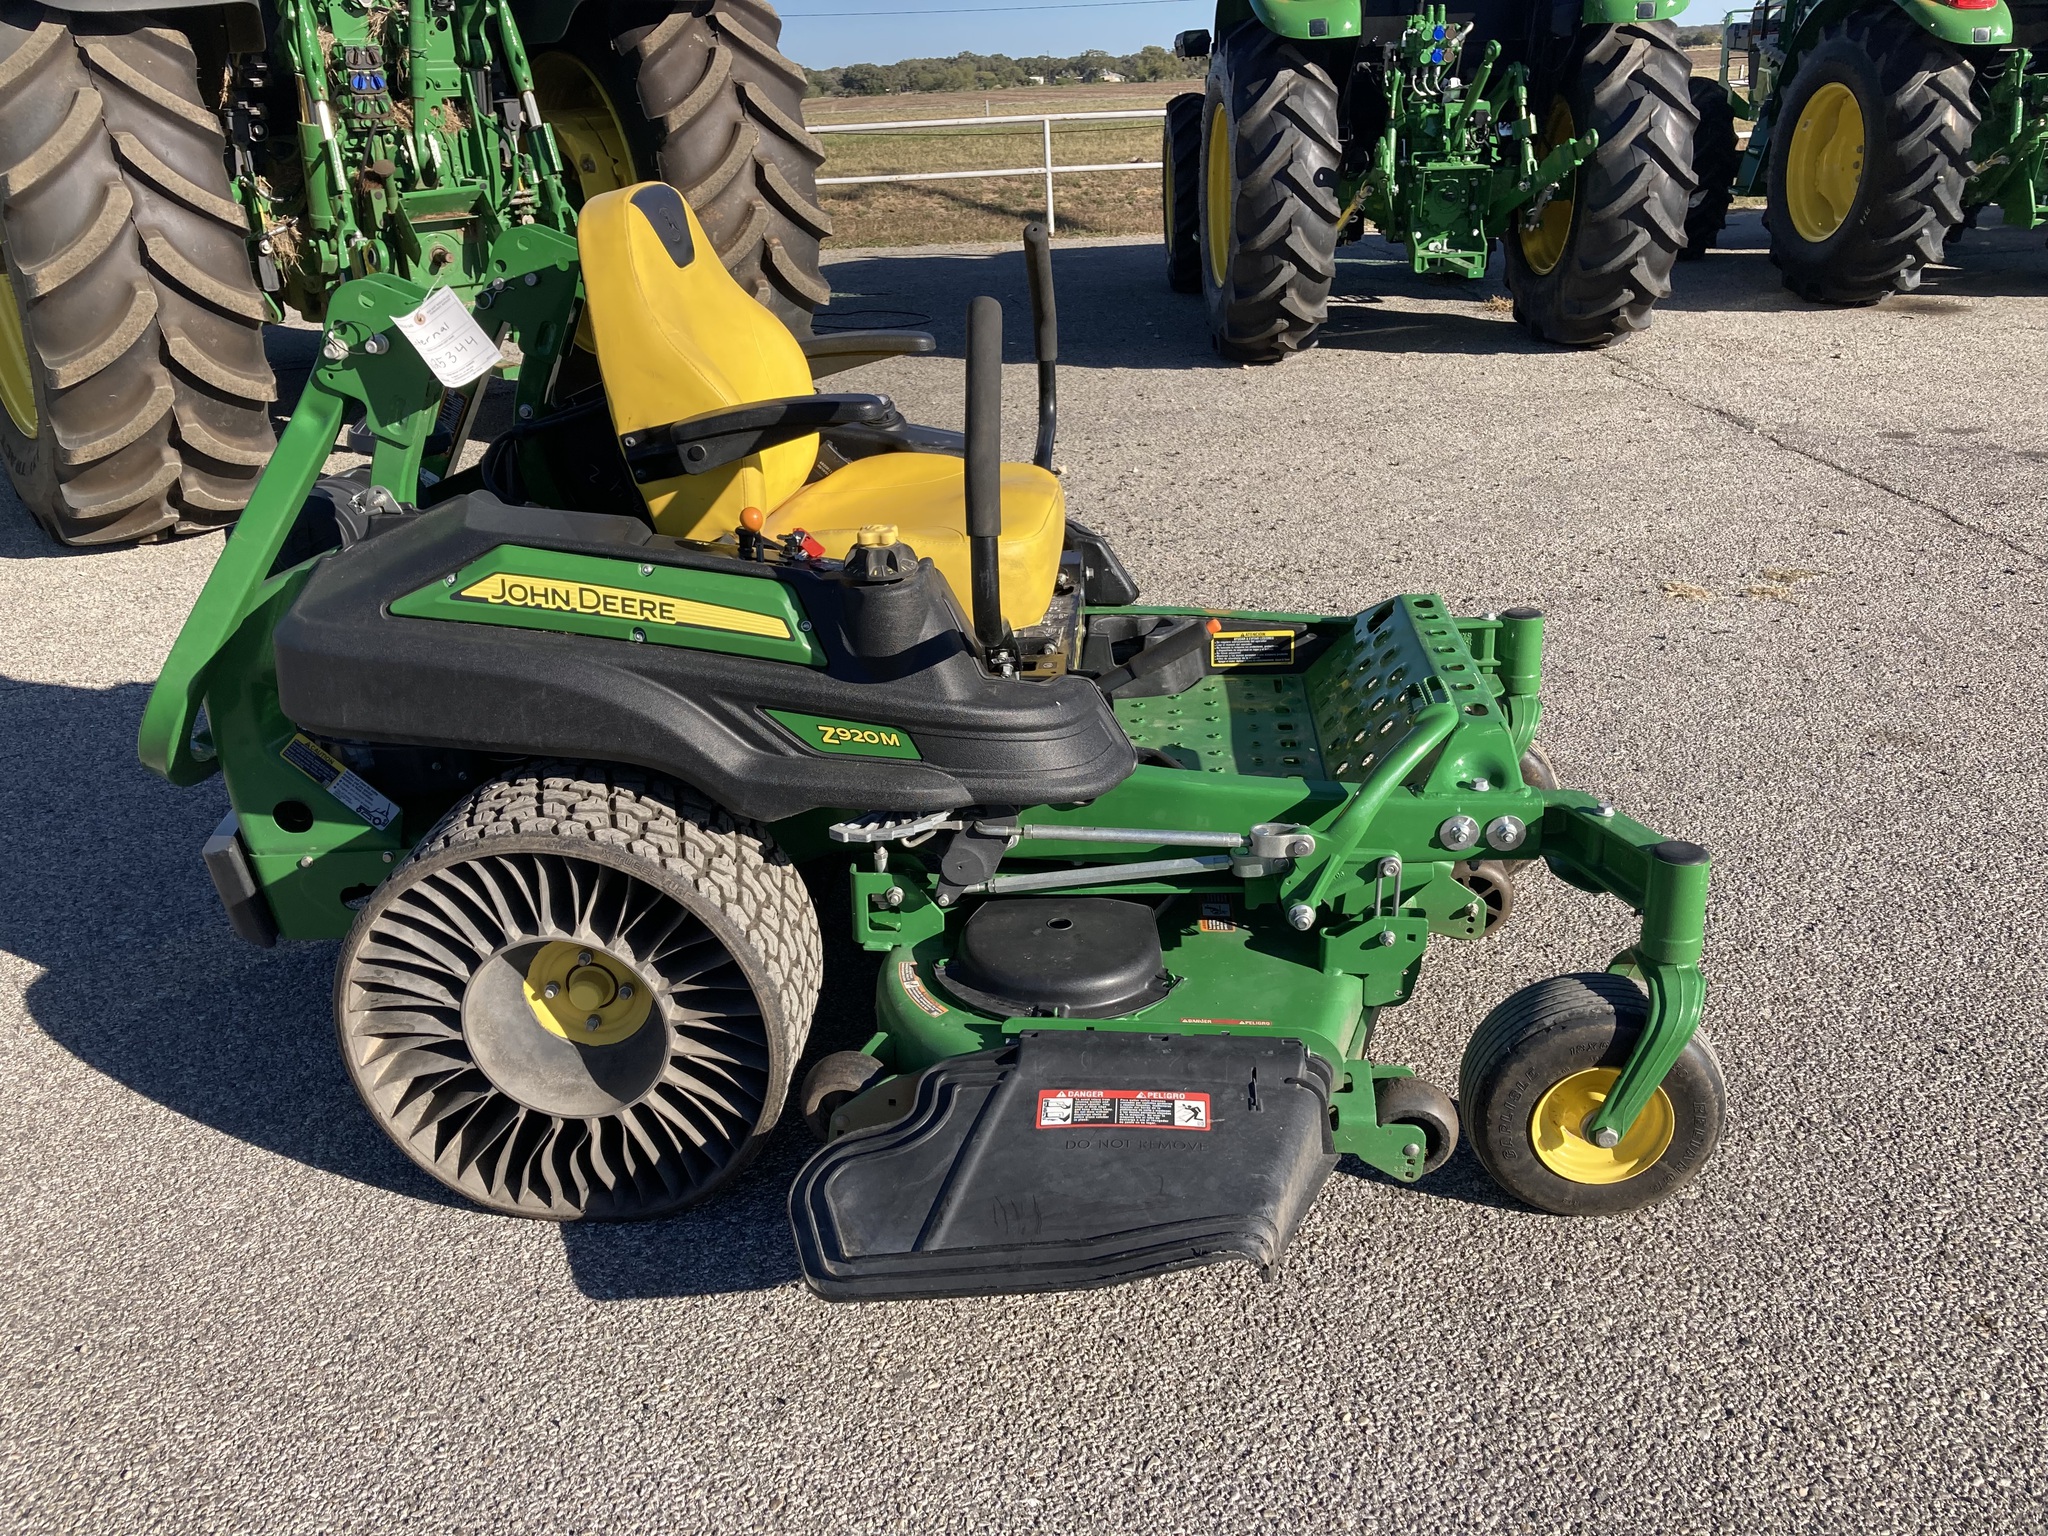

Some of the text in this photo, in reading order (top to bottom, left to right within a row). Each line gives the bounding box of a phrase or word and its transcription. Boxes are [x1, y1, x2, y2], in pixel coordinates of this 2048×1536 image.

[490, 578, 676, 621] JOHN DEERE
[817, 724, 901, 747] Z920M
[310, 744, 335, 765] CAUTION
[615, 853, 660, 880] TWEEL
[1067, 1090, 1104, 1098] DANGER
[1147, 1091, 1186, 1100] PELIGRO
[1065, 1138, 1209, 1152] DO NOT REMOVE
